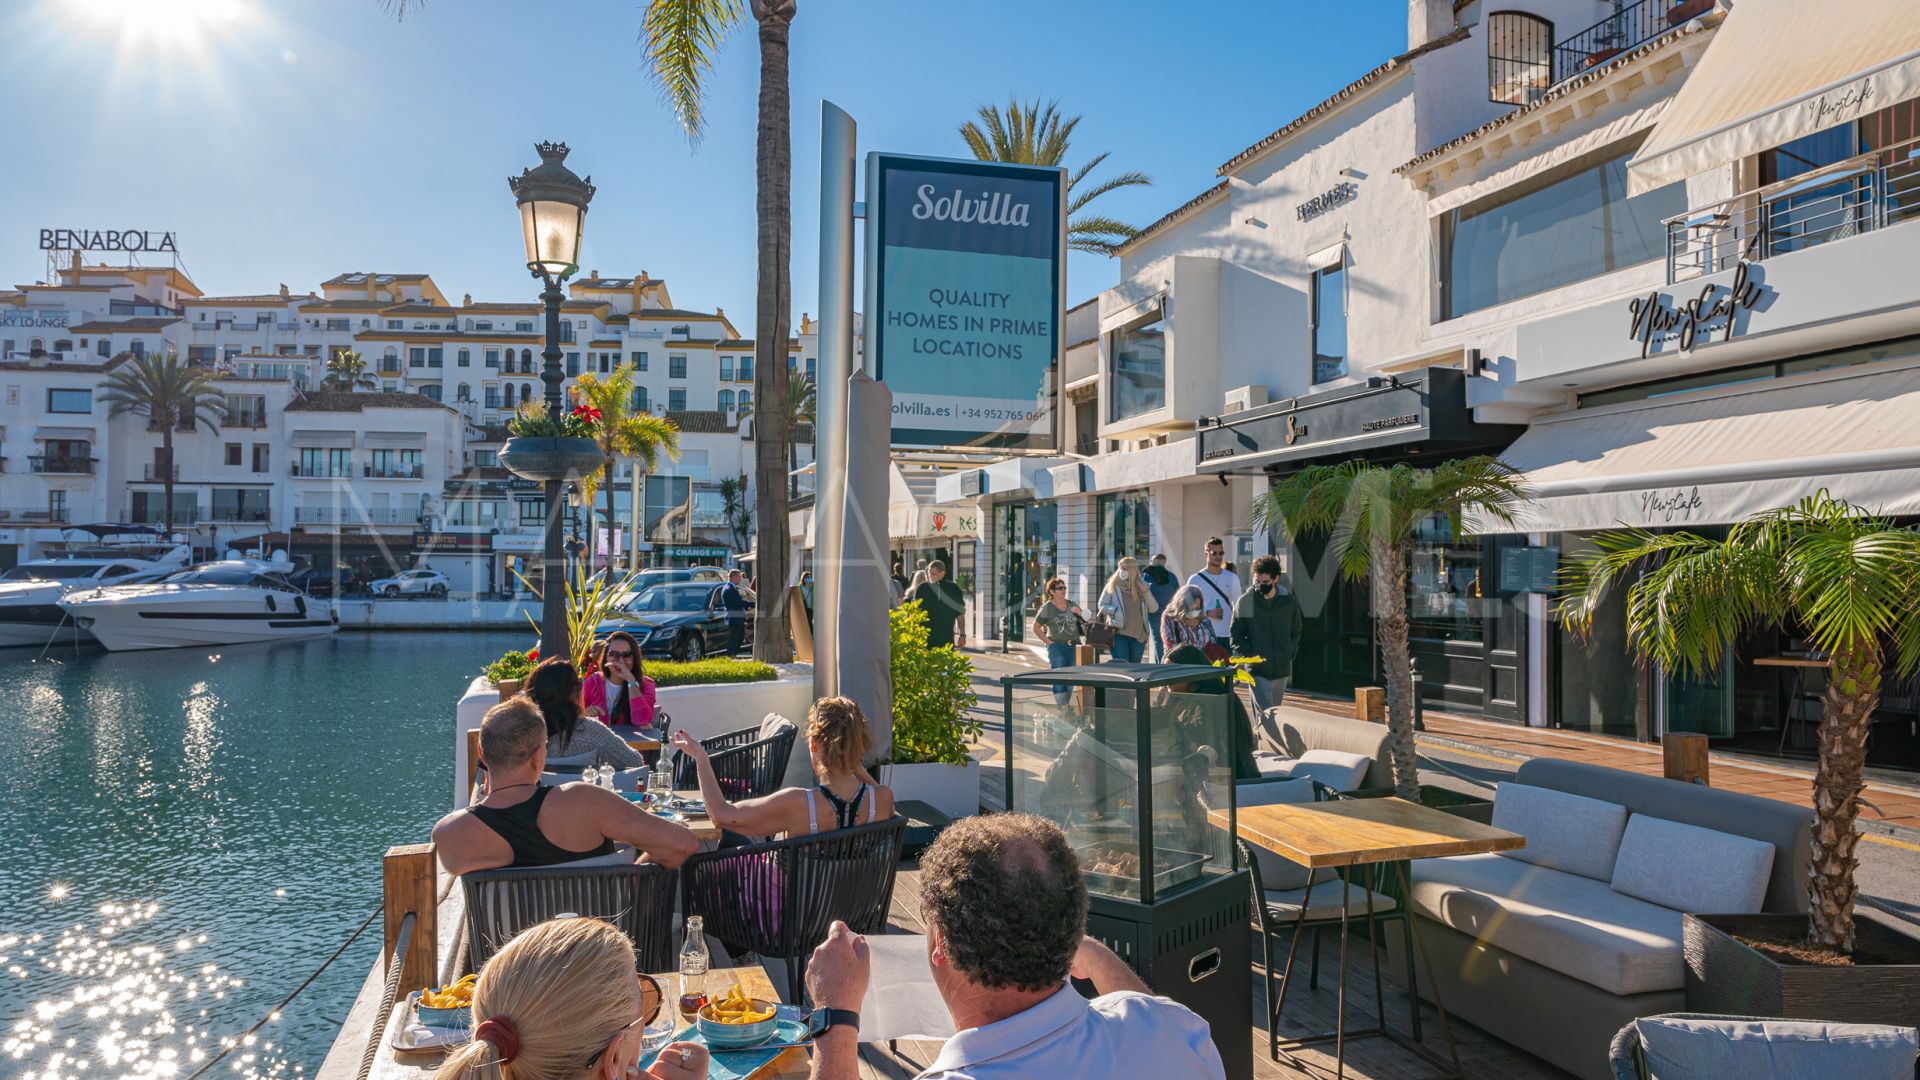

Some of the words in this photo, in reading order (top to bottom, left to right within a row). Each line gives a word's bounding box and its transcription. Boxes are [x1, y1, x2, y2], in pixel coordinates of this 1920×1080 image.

[912, 183, 1030, 227] Solvilla
[40, 229, 176, 252] BENABOLA
[929, 288, 1011, 309] QUALITY
[20, 317, 68, 328] LOUNGE
[888, 311, 959, 331] HOMES
[964, 316, 984, 333] IN
[990, 318, 1048, 337] PRIME
[913, 337, 1022, 360] LOCATIONS
[961, 408, 981, 419] +34
[984, 409, 1002, 419] 952
[1005, 410, 1023, 420] 765
[675, 549, 711, 557] CHANGE
